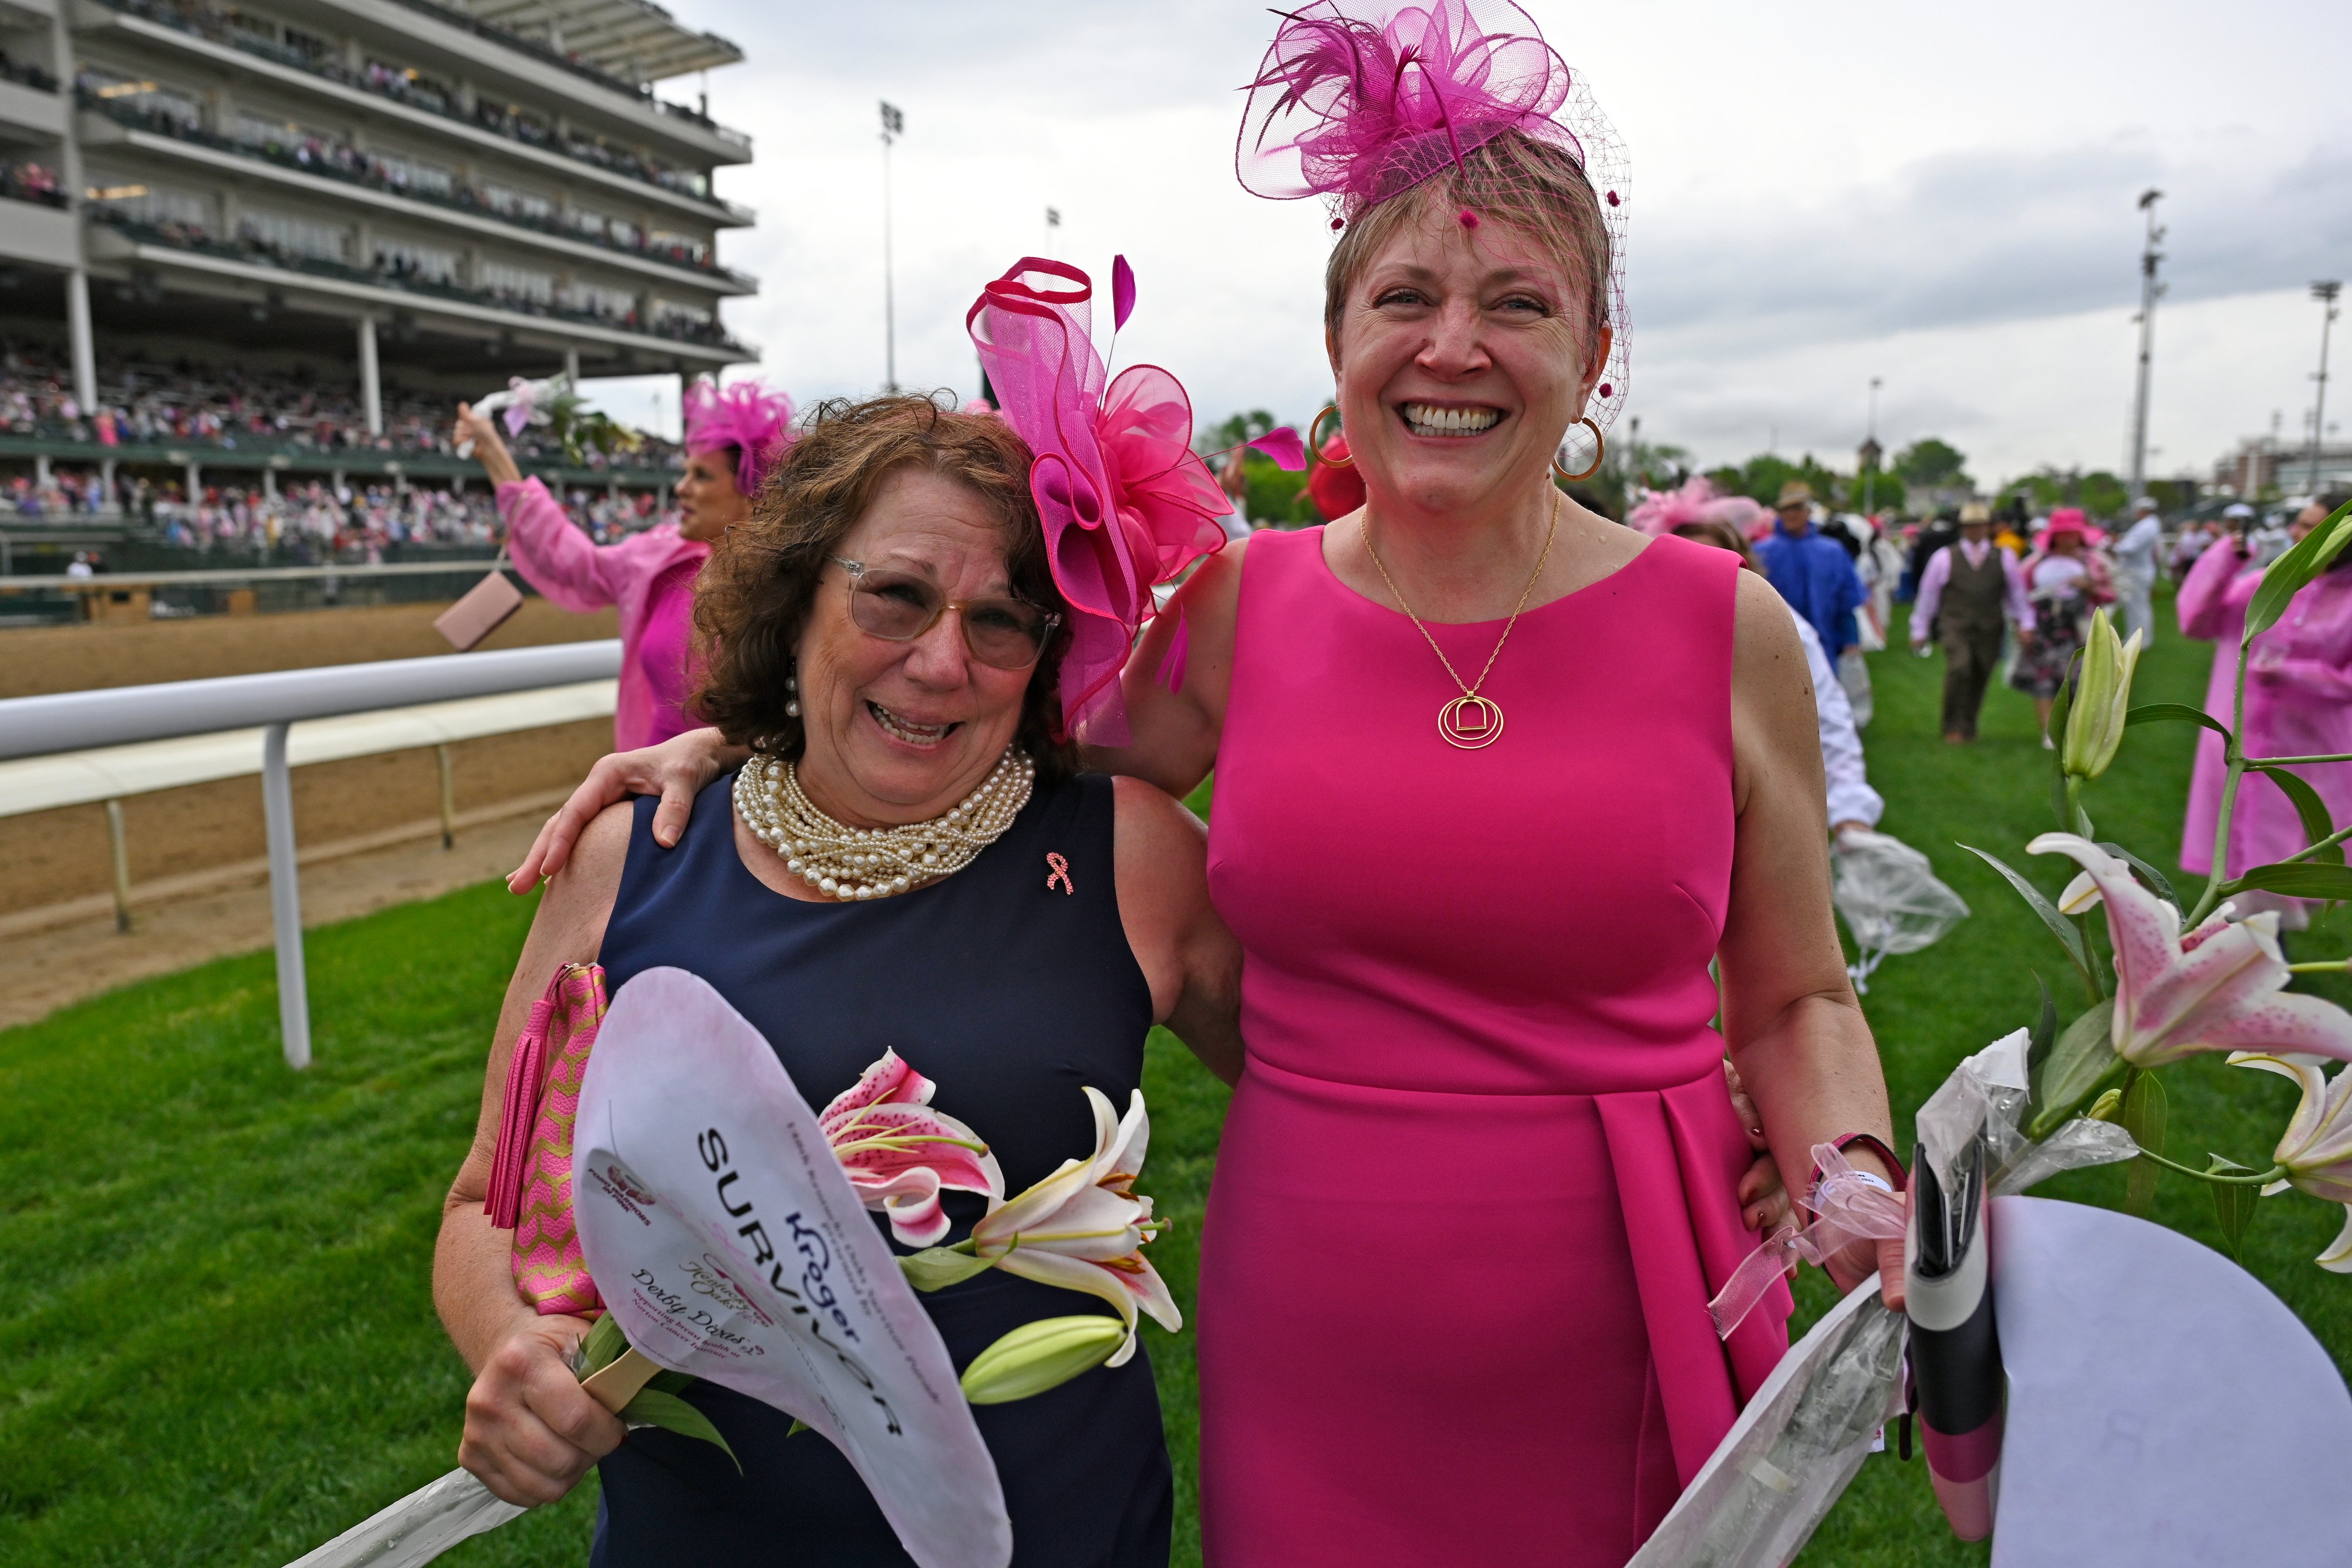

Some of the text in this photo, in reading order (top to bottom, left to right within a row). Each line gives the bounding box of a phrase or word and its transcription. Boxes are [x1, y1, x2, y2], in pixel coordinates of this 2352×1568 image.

[602, 1186, 629, 1213] IN PINK
[612, 1187, 651, 1226] WARRIORS
[679, 1261, 750, 1310] Kentucky
[690, 1280, 733, 1310] Oaks
[696, 1127, 903, 1436] SURVIVOR
[785, 1211, 861, 1343] Kroger
[632, 1268, 745, 1344] Derby Divas
[632, 1298, 659, 1323] Norton
[660, 1322, 690, 1343] Cancer
[690, 1341, 727, 1359] Institute
[675, 1321, 701, 1340] breast
[701, 1339, 729, 1352] health
[730, 1350, 741, 1359] at
